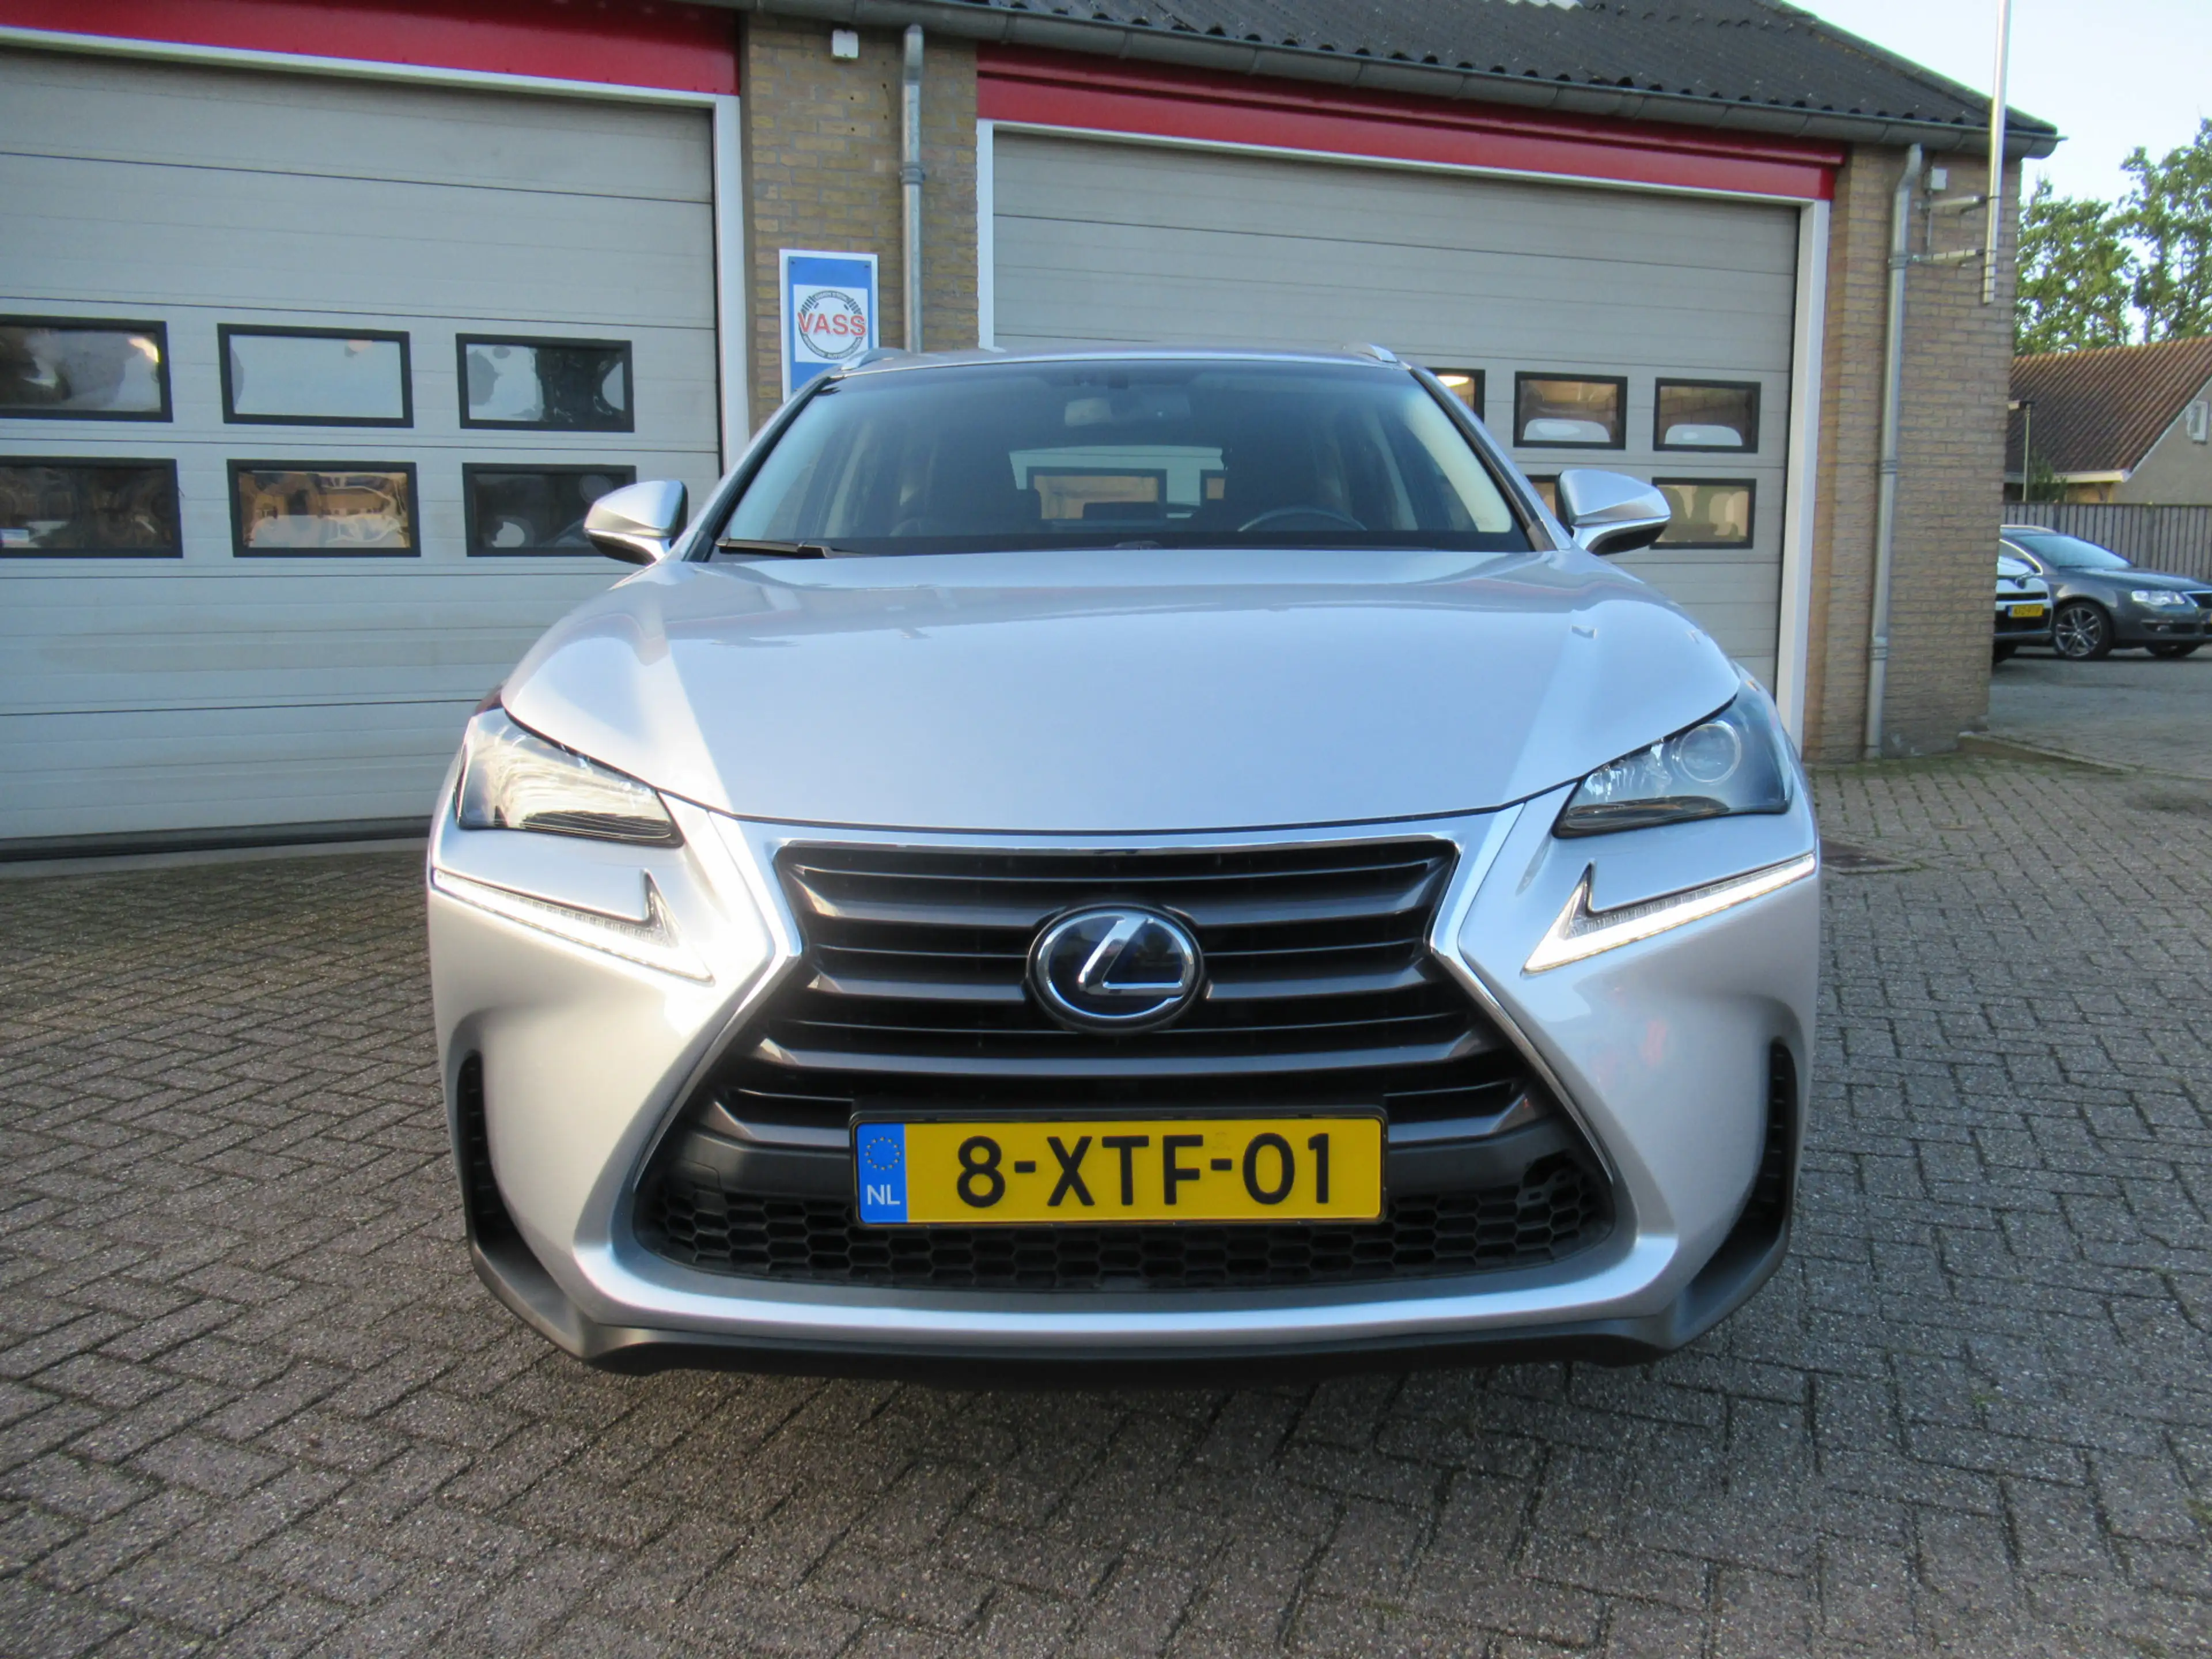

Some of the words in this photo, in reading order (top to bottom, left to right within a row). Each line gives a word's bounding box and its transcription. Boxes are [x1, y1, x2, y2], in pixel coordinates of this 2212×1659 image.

[797, 312, 866, 337] VASS
[956, 1132, 1330, 1208] 8-XTF-01
[867, 1184, 900, 1205] NL
